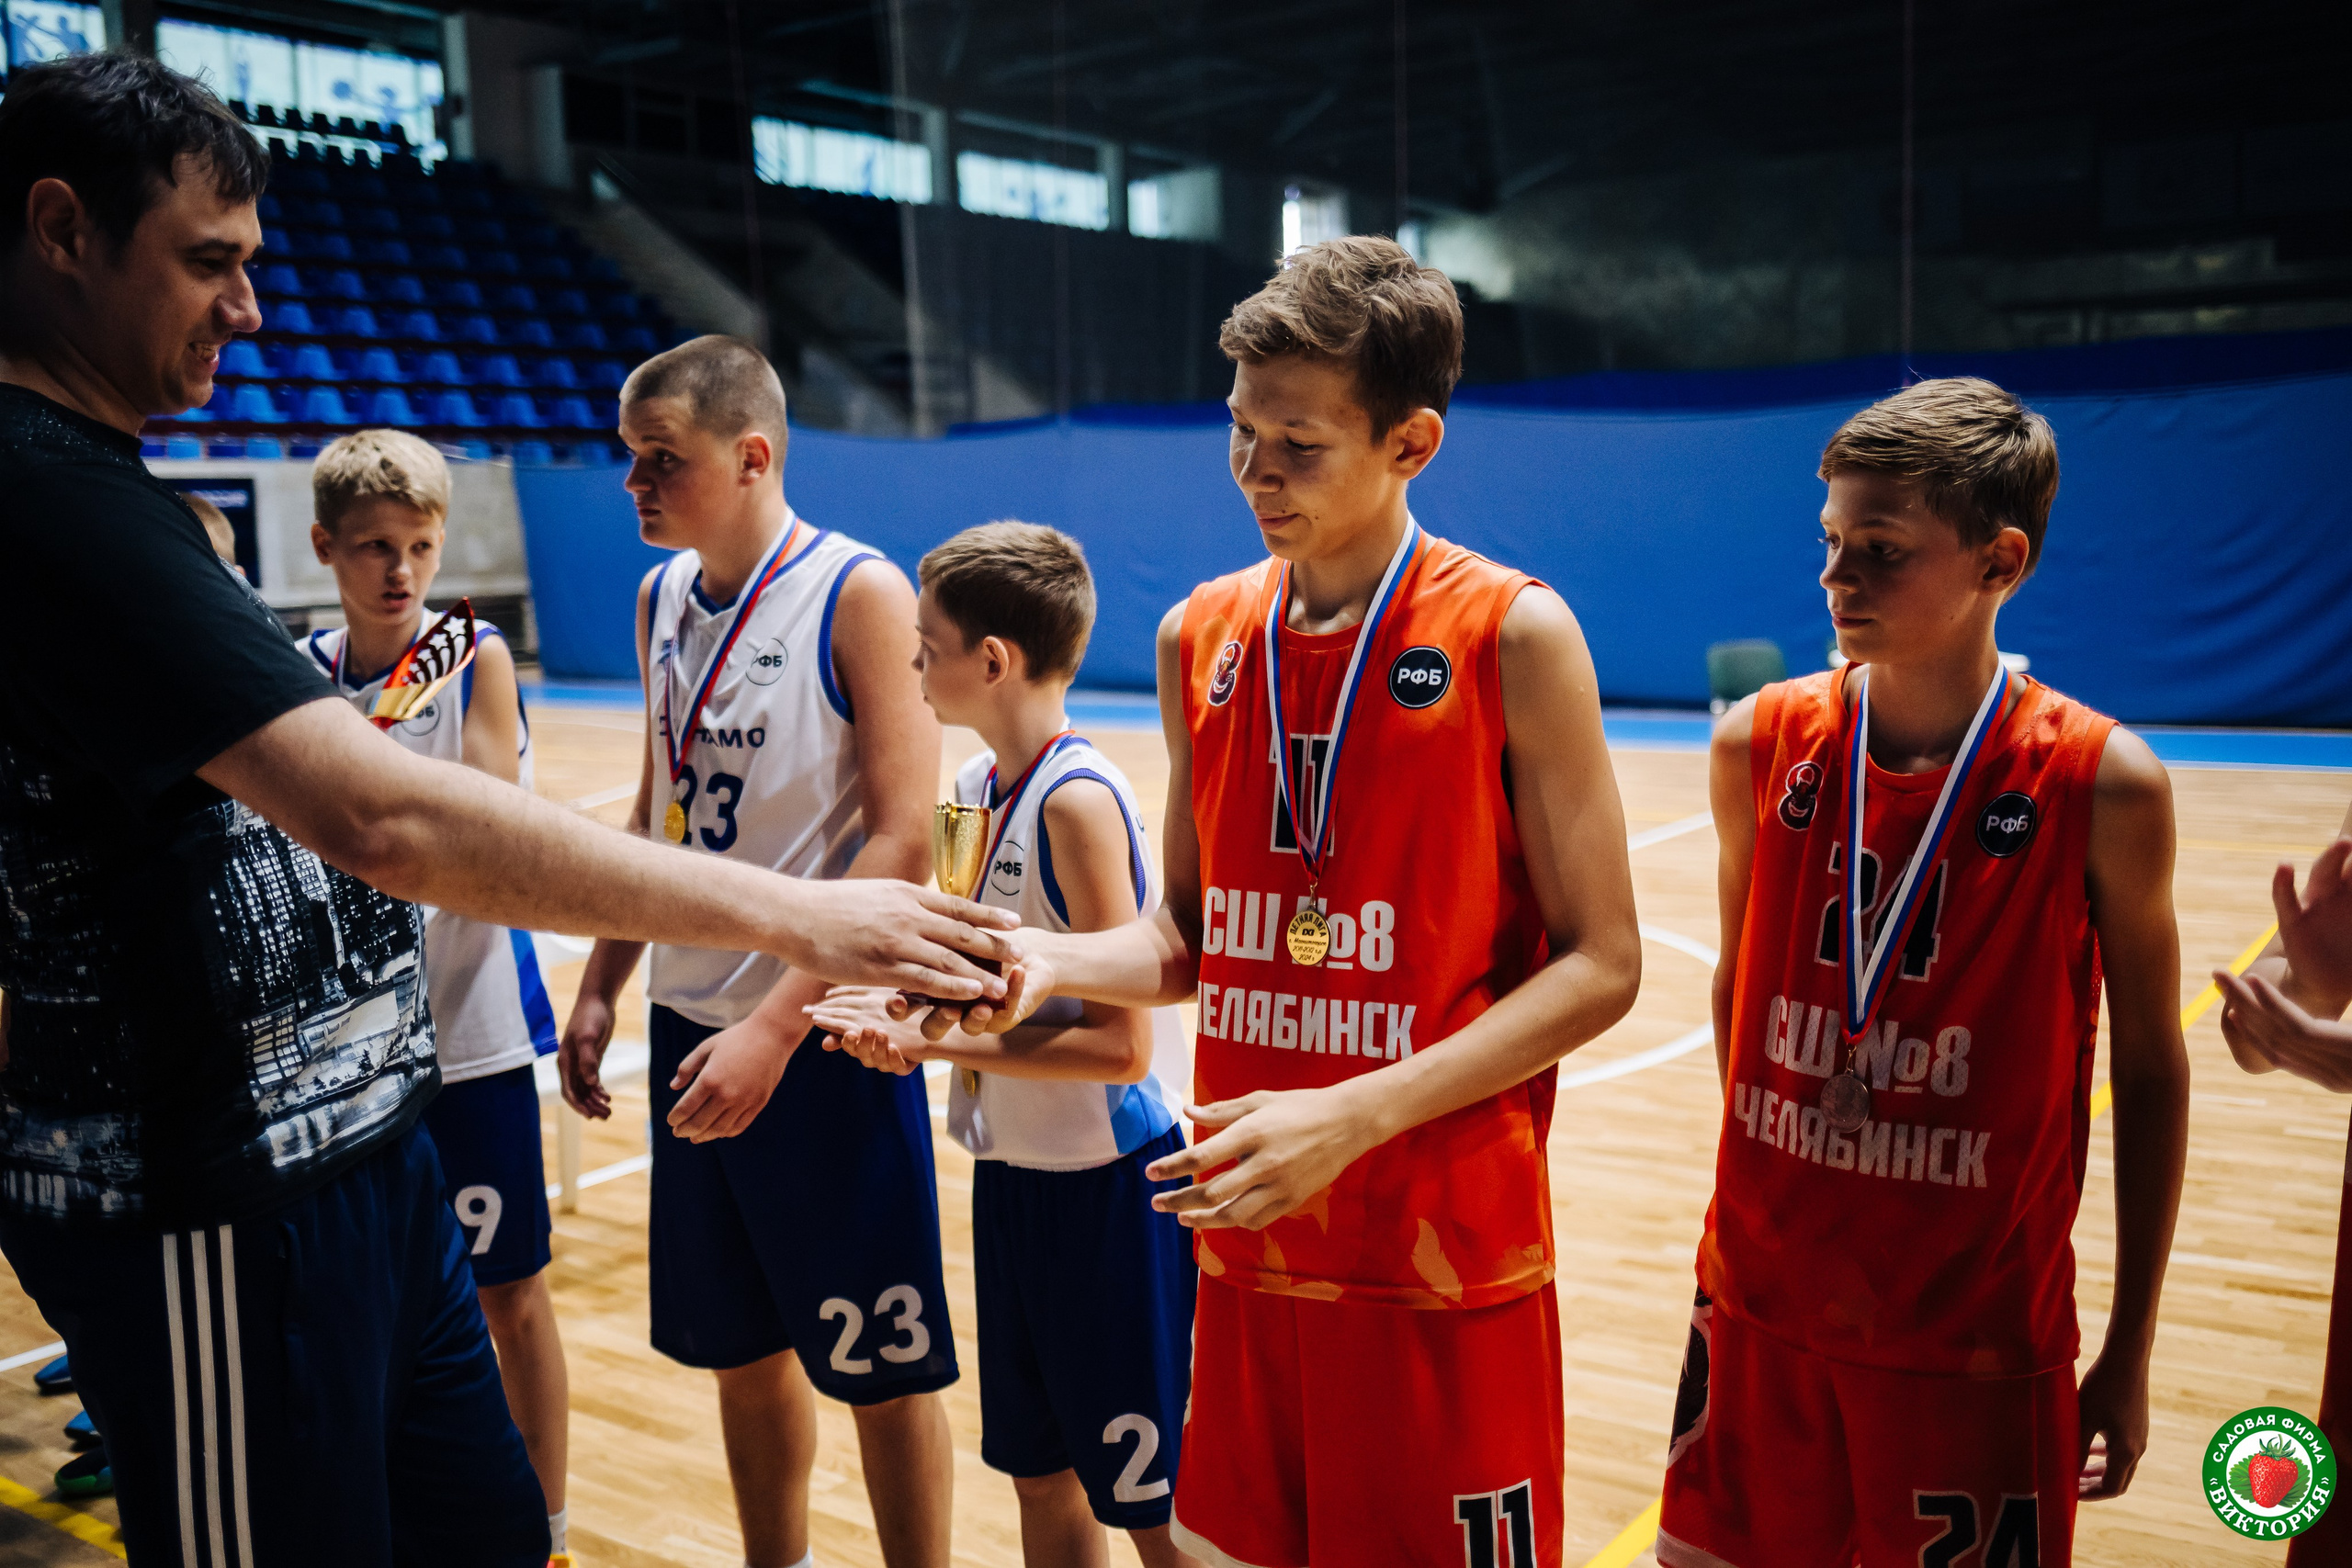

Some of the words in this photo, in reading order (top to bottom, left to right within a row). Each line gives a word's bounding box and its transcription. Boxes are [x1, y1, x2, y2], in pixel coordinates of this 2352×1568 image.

[752, 654, 783, 668] ФБ
[1397, 667, 1442, 686] РФБ
[673, 764, 744, 852] 23
[1268, 732, 1336, 857] 11
[1985, 814, 2030, 834] РФБ
[994, 859, 1023, 877] РФБ
[1814, 840, 1950, 983] 24
[1202, 886, 1282, 962] СШ
[1764, 995, 1841, 1079] СШ
[1852, 1018, 1973, 1098] №8
[1735, 1082, 1992, 1189] ЧЕЛЯБИНСК
[455, 1185, 503, 1255] 9
[819, 1284, 932, 1376] 23
[1102, 1413, 1170, 1504] 2
[1453, 1477, 1538, 1568] 11
[1912, 1489, 2041, 1568] 24
